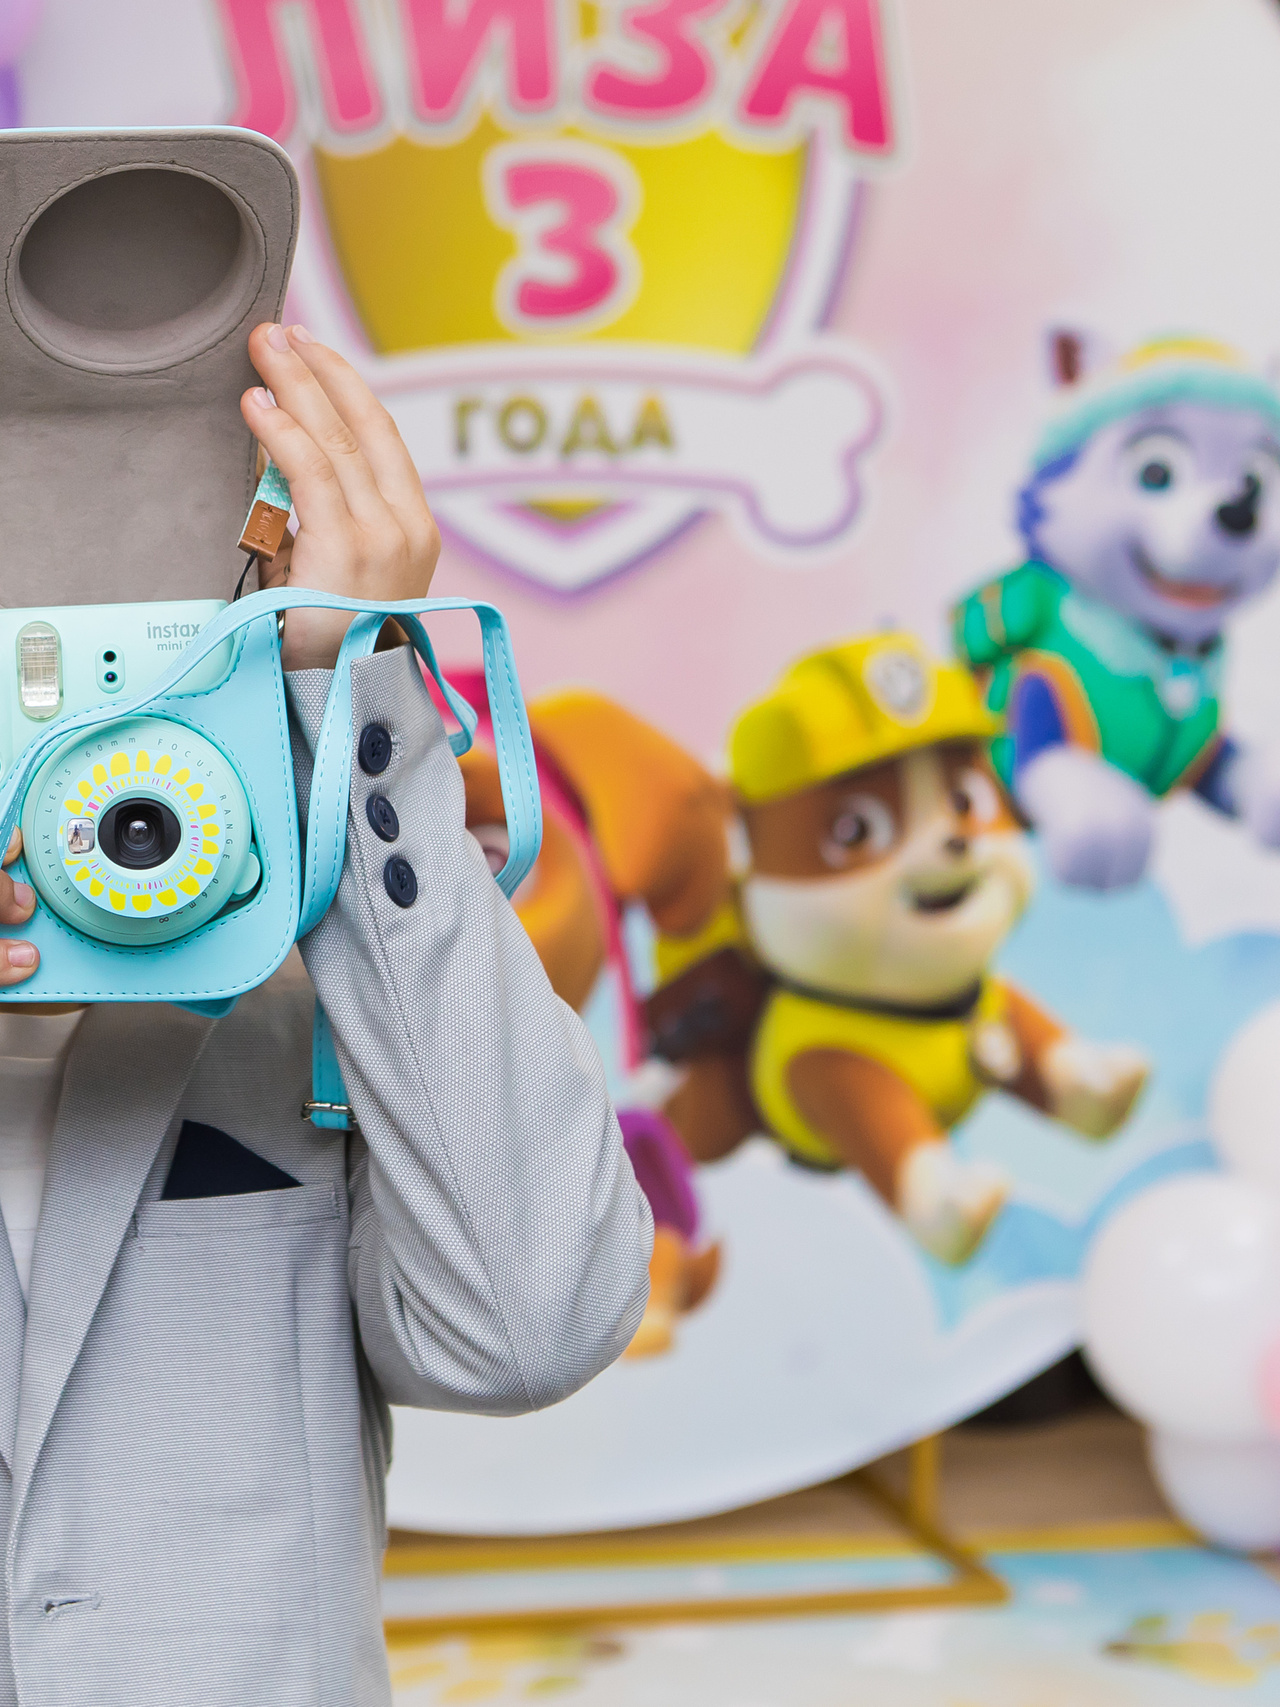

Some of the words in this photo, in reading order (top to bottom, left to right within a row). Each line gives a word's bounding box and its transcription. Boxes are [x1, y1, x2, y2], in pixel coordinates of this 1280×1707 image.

[225, 0, 896, 151] ЛИЗА
[503, 160, 620, 319] 3
[452, 396, 676, 459] ГОДА
[146, 621, 200, 639] instax
[157, 640, 183, 651] mini
[85, 737, 136, 758] 60mm
[157, 738, 214, 777] FOCUS
[44, 768, 72, 814] LENS
[220, 794, 234, 860] RANGE
[42, 834, 80, 904] INSTAX
